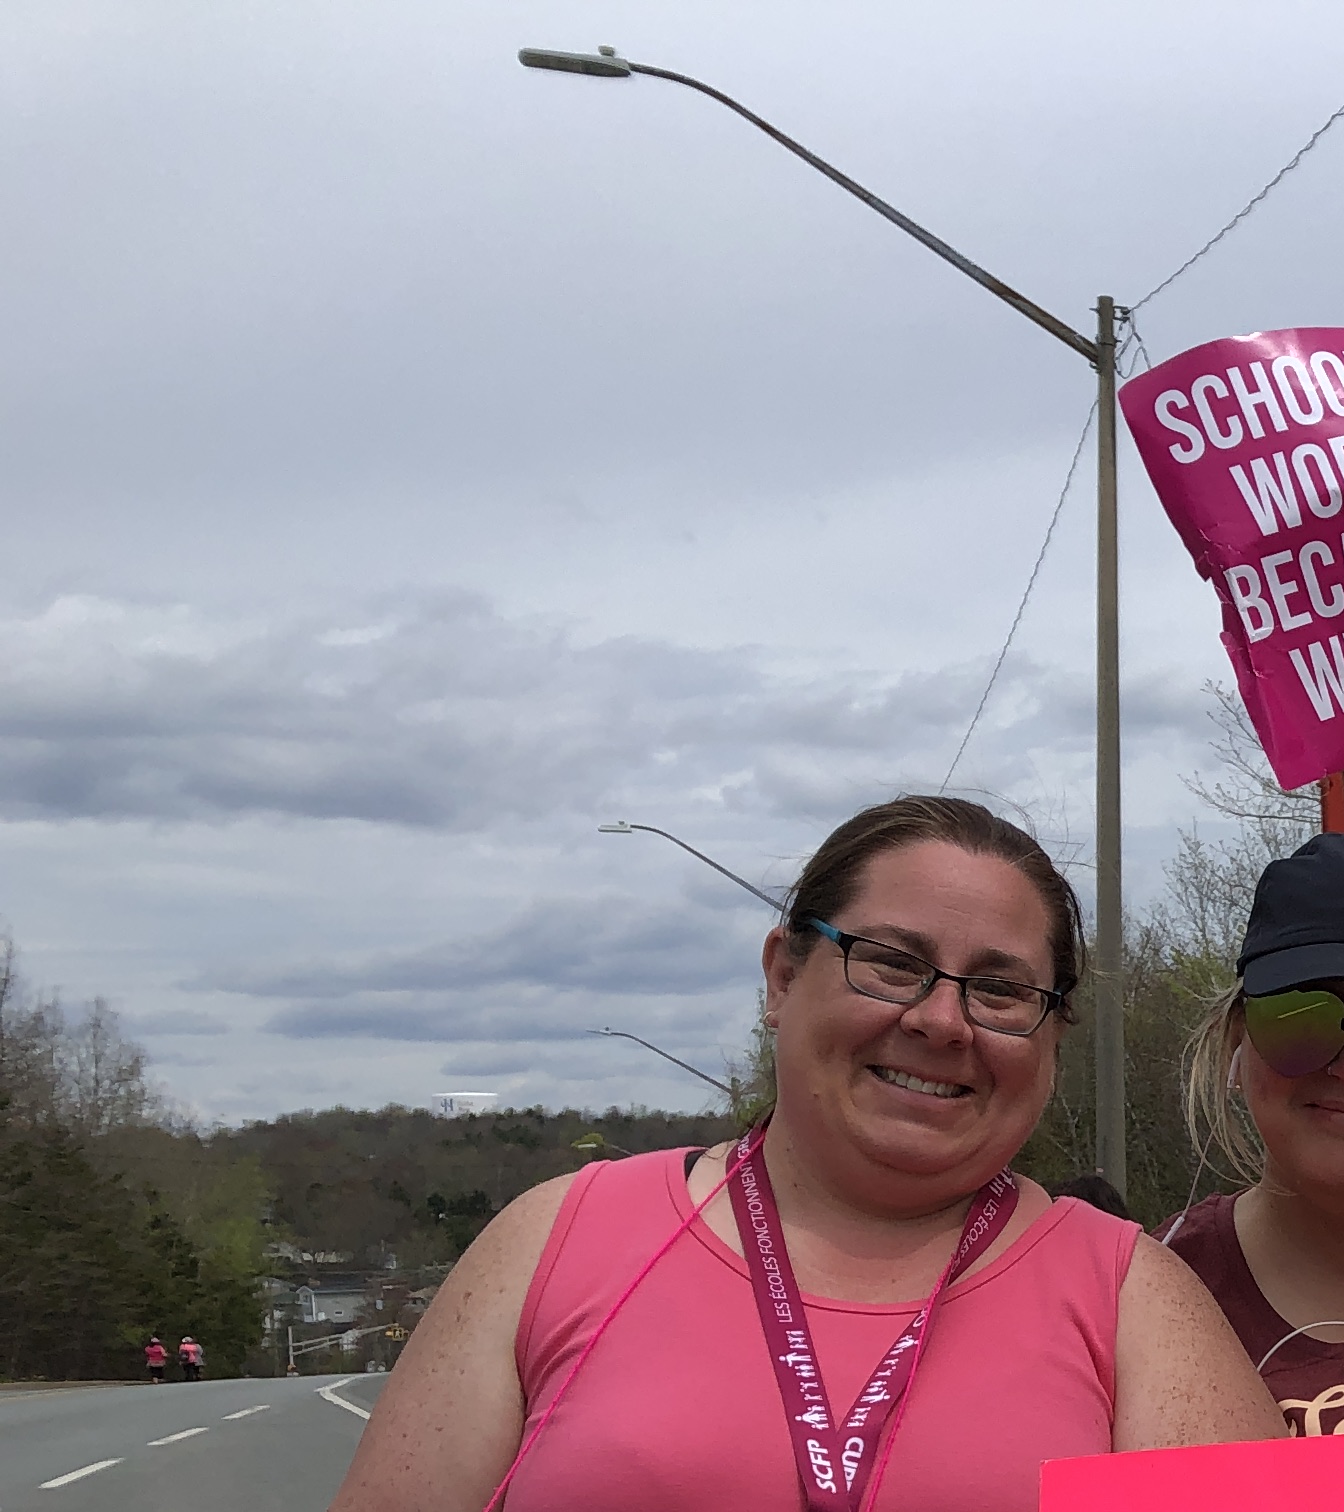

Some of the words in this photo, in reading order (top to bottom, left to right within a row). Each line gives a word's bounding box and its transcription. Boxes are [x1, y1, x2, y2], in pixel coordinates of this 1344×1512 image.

[739, 1160, 775, 1255] FONCTIONNENT
[982, 1198, 1001, 1222] LES
[761, 1256, 788, 1300] ÉCOLES
[773, 1302, 794, 1323] LES
[806, 1438, 837, 1494] SCFP
